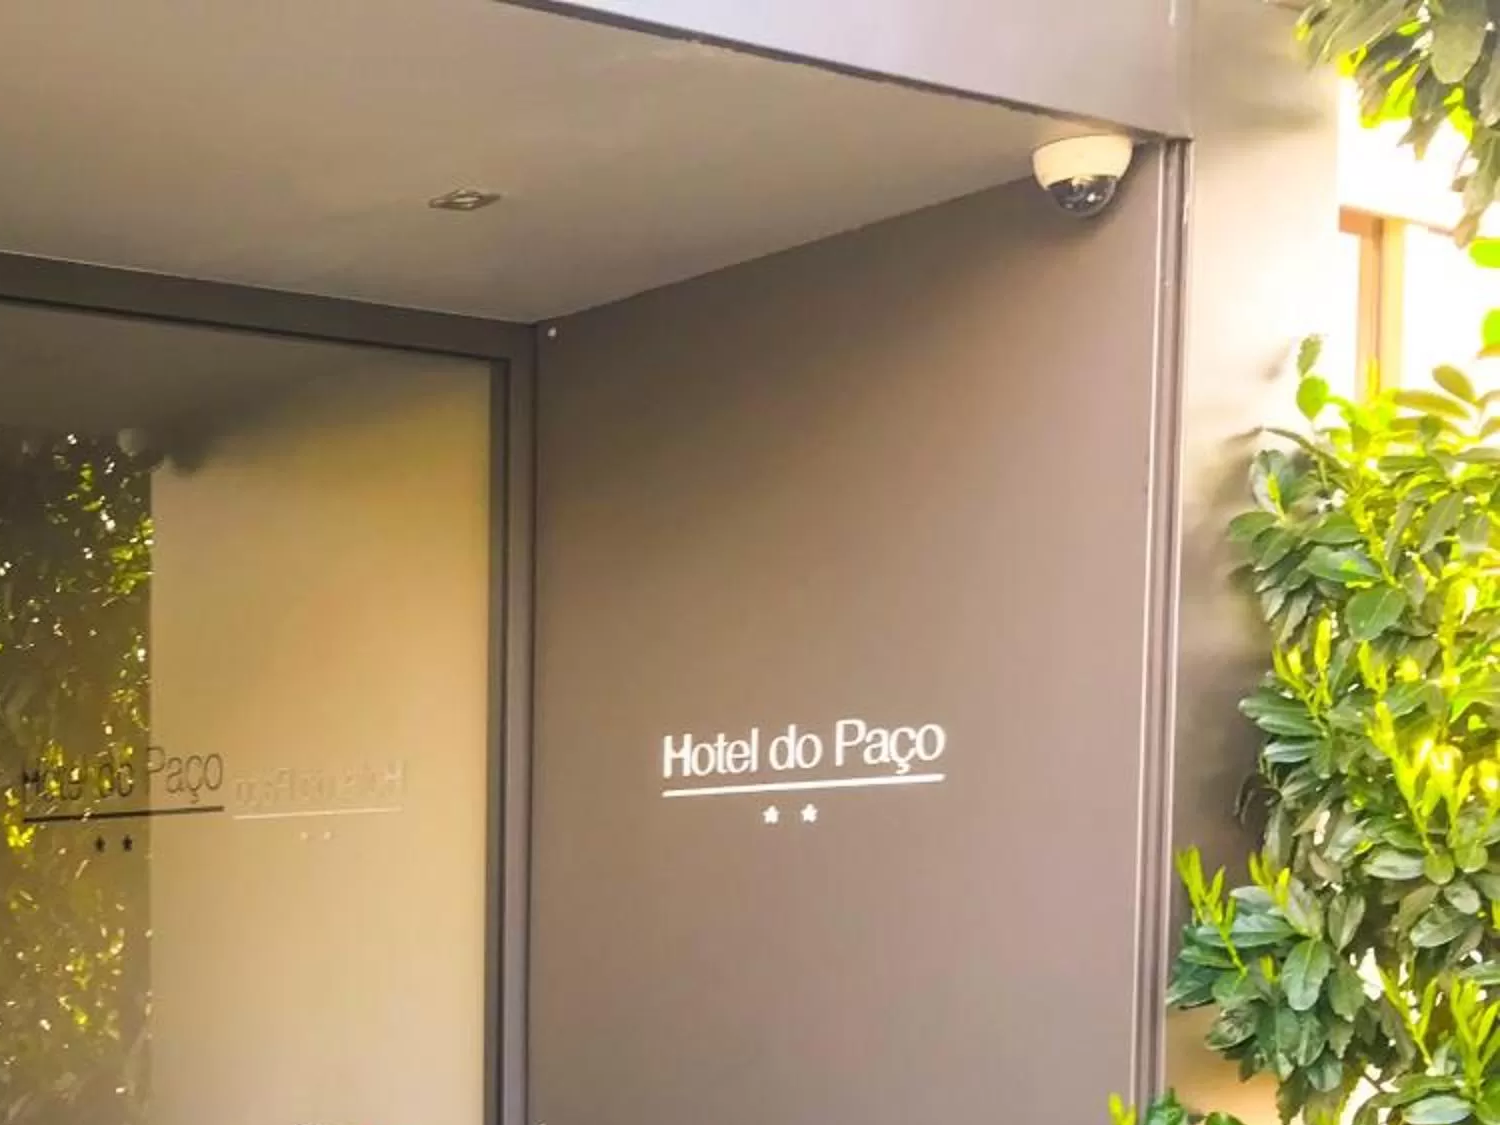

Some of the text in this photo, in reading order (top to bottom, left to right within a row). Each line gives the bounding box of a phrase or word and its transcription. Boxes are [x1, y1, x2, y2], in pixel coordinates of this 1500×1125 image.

[146, 746, 224, 804] Paço
[662, 718, 947, 779] Hotel do Paço
